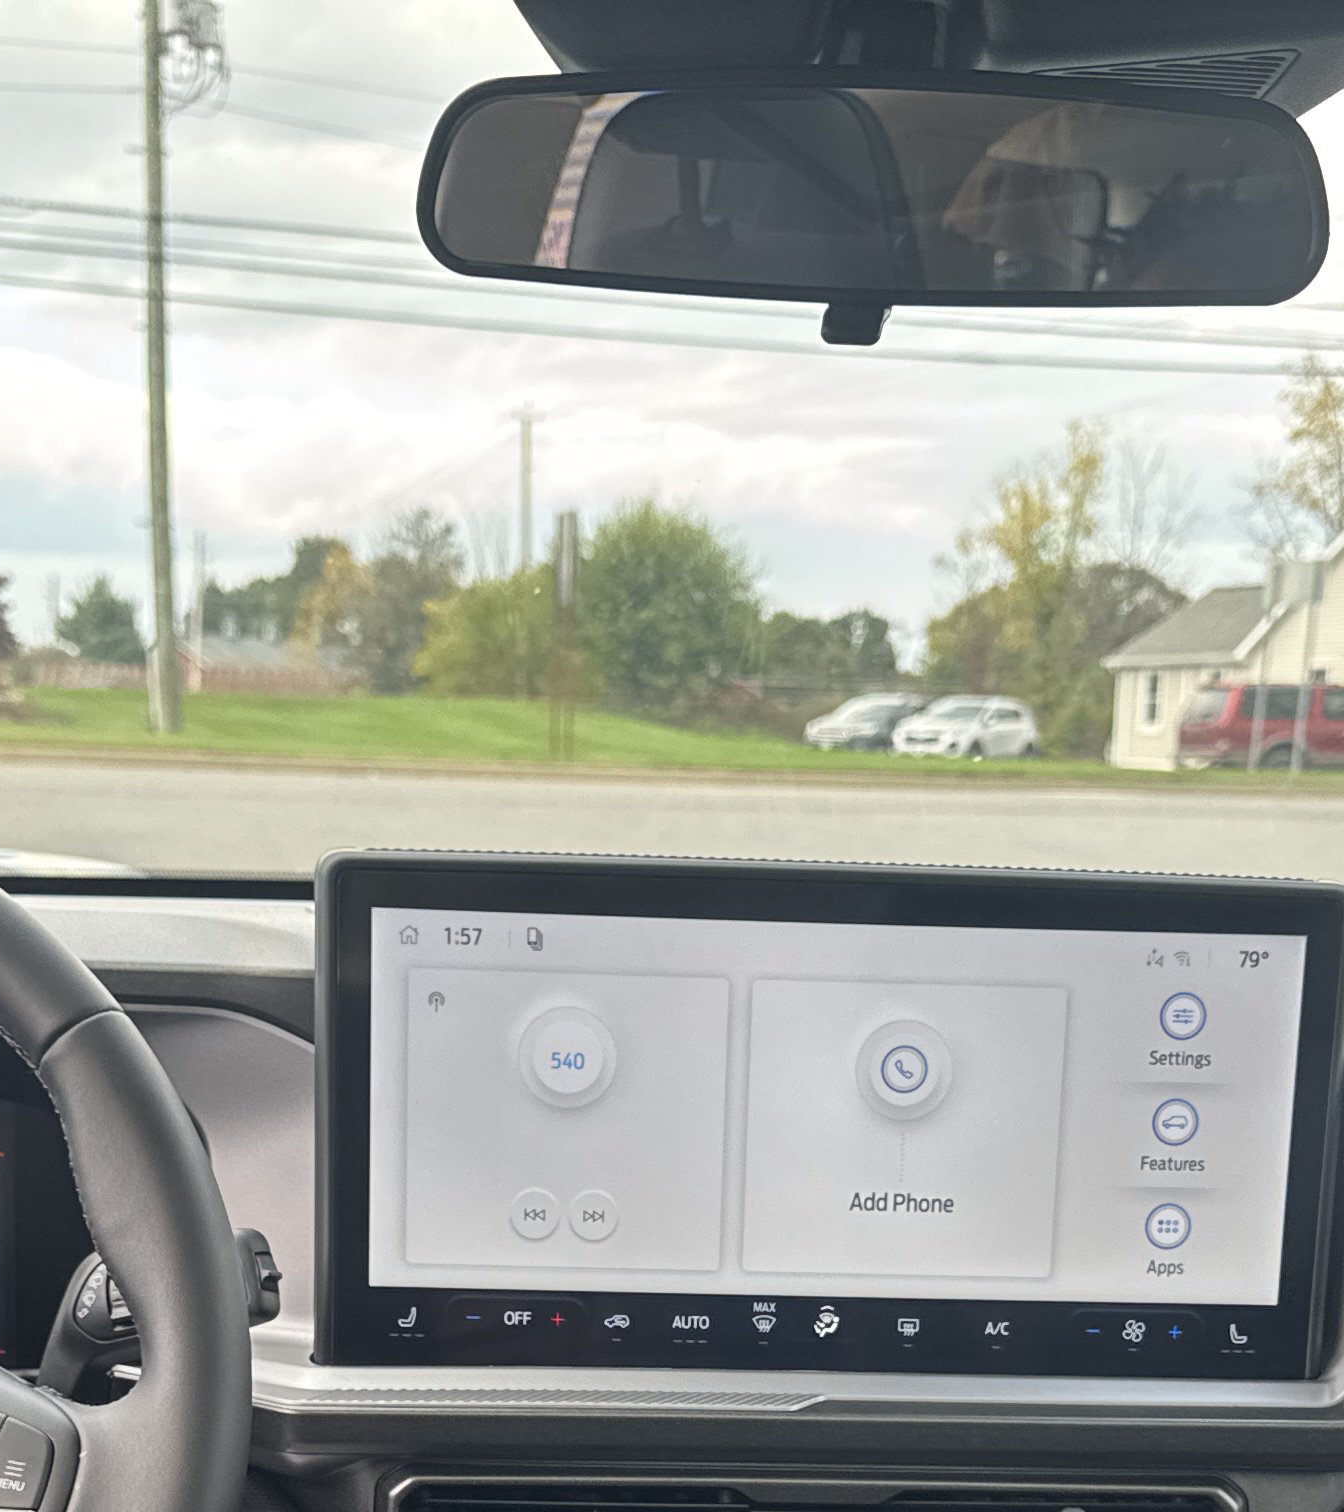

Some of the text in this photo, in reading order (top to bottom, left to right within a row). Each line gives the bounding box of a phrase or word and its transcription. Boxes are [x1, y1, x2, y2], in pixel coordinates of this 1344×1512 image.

[444, 927, 482, 945] 1:57
[1239, 950, 1269, 968] 79°
[551, 1052, 585, 1070] 540
[1148, 1050, 1212, 1069] Settings
[1140, 1156, 1206, 1172] Features
[849, 1192, 954, 1213] Add Phone
[1146, 1260, 1184, 1277] Apps
[753, 1302, 776, 1313] MAX
[504, 1311, 532, 1326] OFF
[672, 1316, 710, 1330] AUTO
[985, 1321, 1010, 1336] A/C
